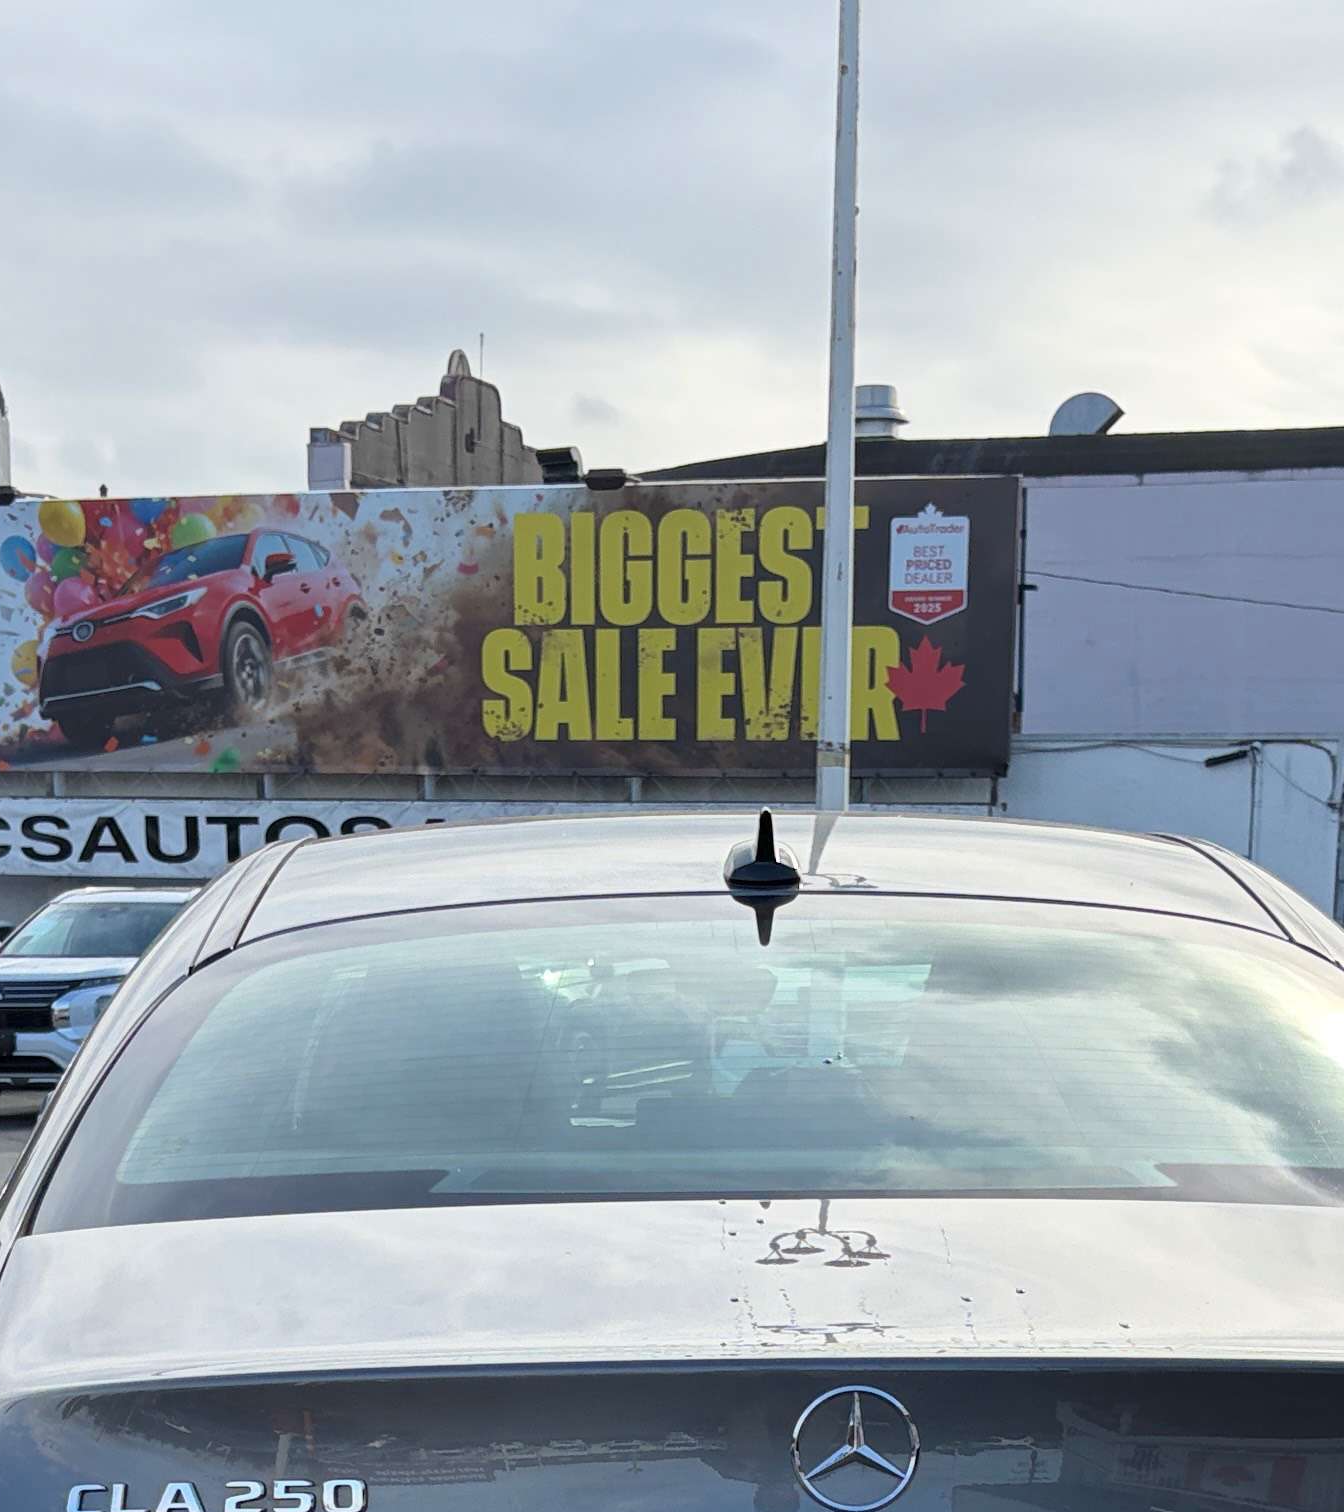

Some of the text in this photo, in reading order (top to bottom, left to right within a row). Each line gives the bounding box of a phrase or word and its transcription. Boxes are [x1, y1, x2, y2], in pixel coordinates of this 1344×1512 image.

[913, 545, 945, 558] BEST
[905, 559, 952, 571] PRICED
[904, 572, 953, 585] DEALER
[481, 627, 677, 742] SALE
